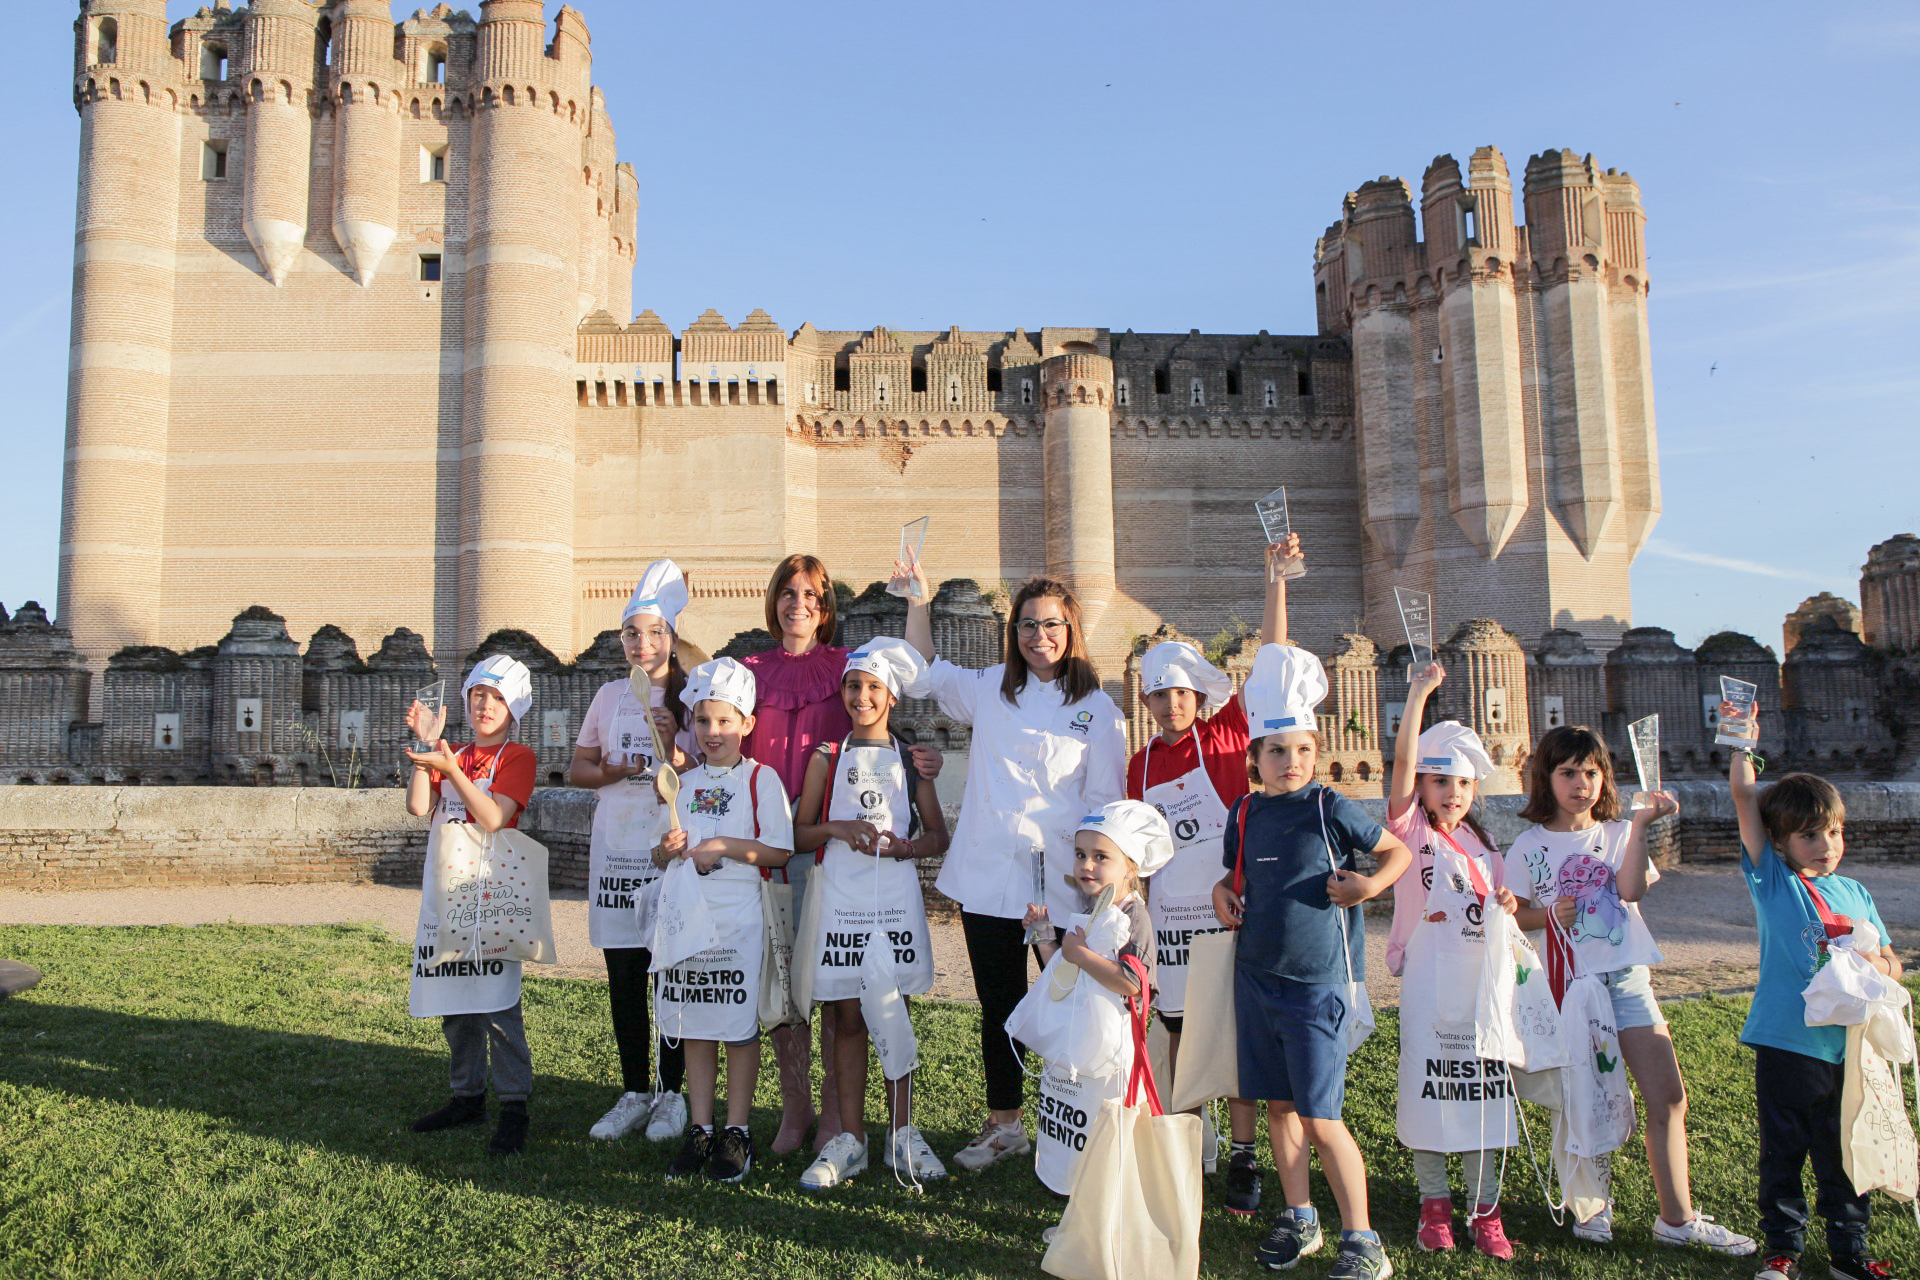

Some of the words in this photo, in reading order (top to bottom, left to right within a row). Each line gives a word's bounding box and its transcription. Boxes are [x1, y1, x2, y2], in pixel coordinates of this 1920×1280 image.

[1166, 793, 1199, 811] Diputación
[1169, 809, 1179, 817] de
[1178, 800, 1202, 813] Segovia
[605, 855, 632, 863] Nuestras
[599, 876, 660, 893] NUEST
[446, 902, 532, 929] Happiness
[834, 908, 865, 917] Nuestras
[1160, 904, 1191, 913] Nuestras
[1164, 915, 1169, 925] y
[820, 948, 916, 967] ALIMTO
[415, 960, 504, 978] ALIMENTO
[665, 969, 745, 986] NUESTRO
[661, 985, 748, 1005] ALIMENTO
[1435, 1030, 1461, 1041] Nuestras
